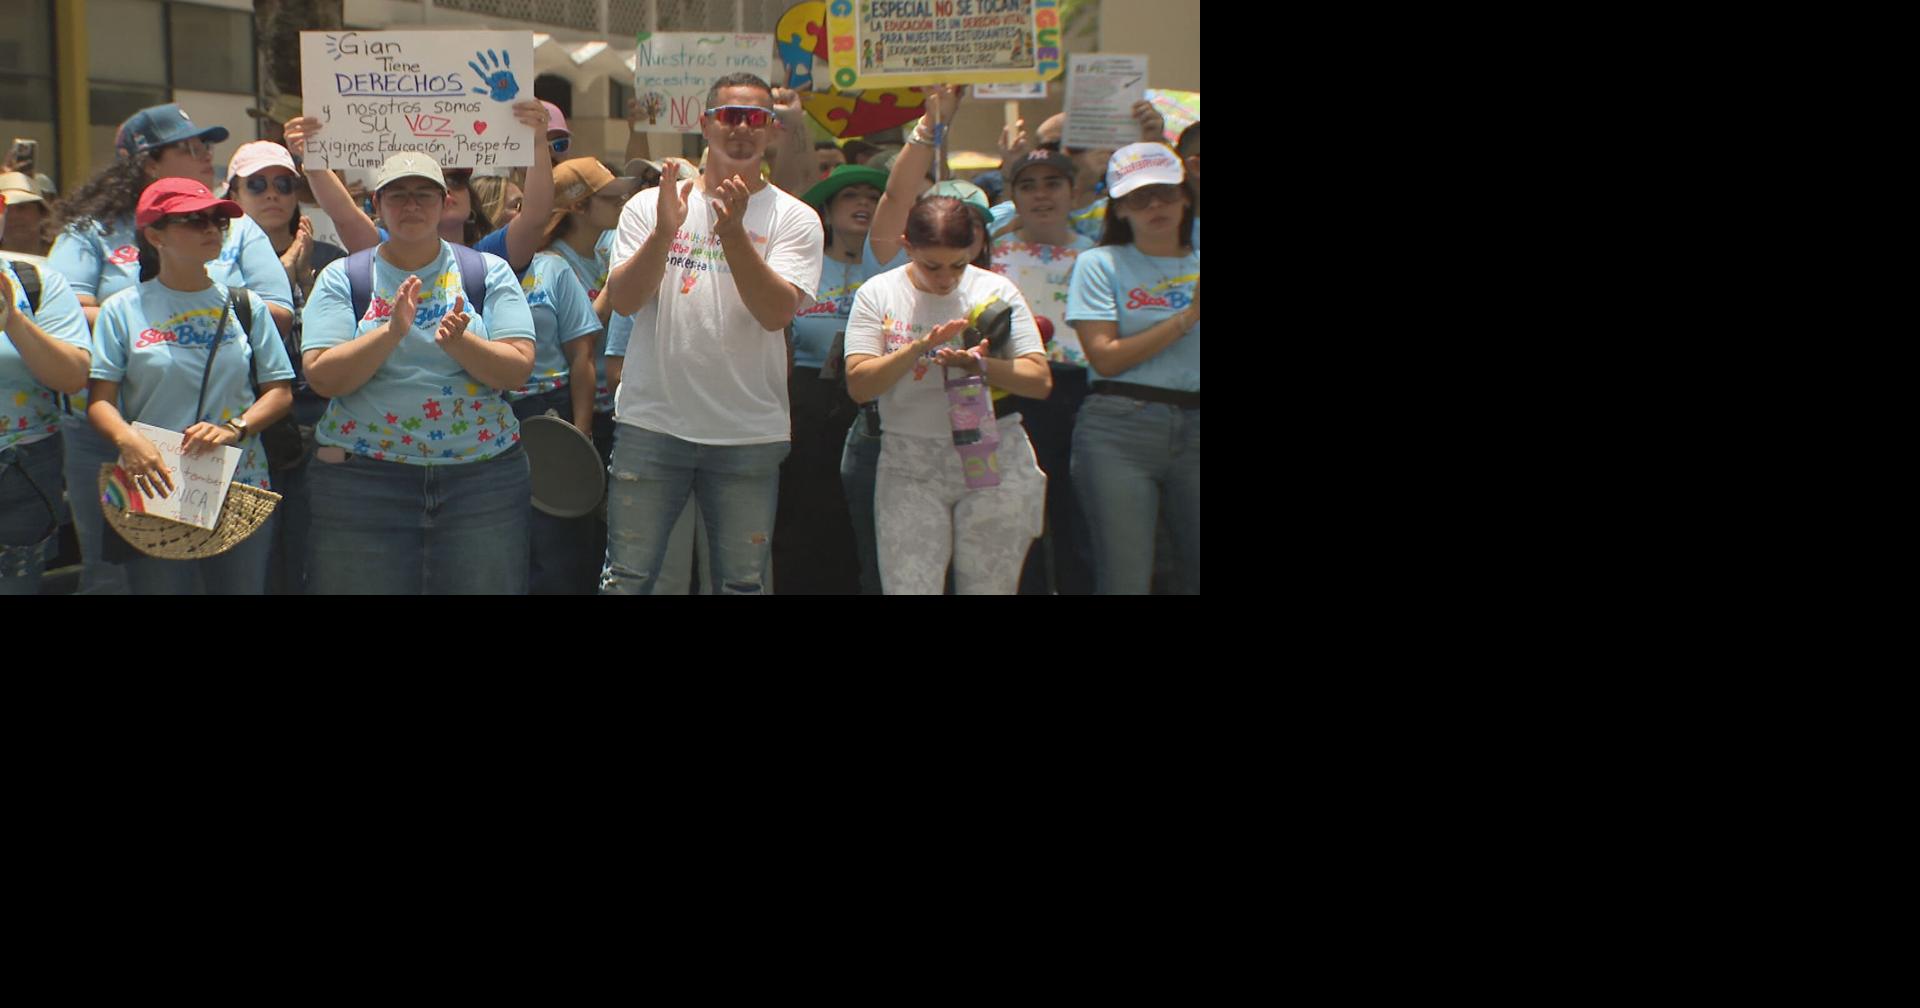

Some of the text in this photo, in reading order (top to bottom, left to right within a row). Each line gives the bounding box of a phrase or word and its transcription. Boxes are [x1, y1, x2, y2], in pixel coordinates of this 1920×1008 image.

[871, 1, 933, 18] ESPECIAL
[935, 0, 953, 17] NO
[957, 0, 973, 16] SE
[870, 19, 882, 32] LA
[936, 18, 947, 30] ES
[338, 32, 402, 56] Gian
[880, 31, 903, 44] PARA
[905, 30, 952, 43] NUESTROS
[639, 41, 718, 67] Nuestros
[376, 57, 421, 73] Tiene
[335, 72, 464, 94] DERECHOS
[347, 97, 421, 116] nosotros
[434, 101, 482, 114] somos
[404, 114, 455, 135] VOZ
[305, 139, 374, 158] Exigimos
[455, 134, 521, 154] Respeto
[440, 153, 459, 166] del
